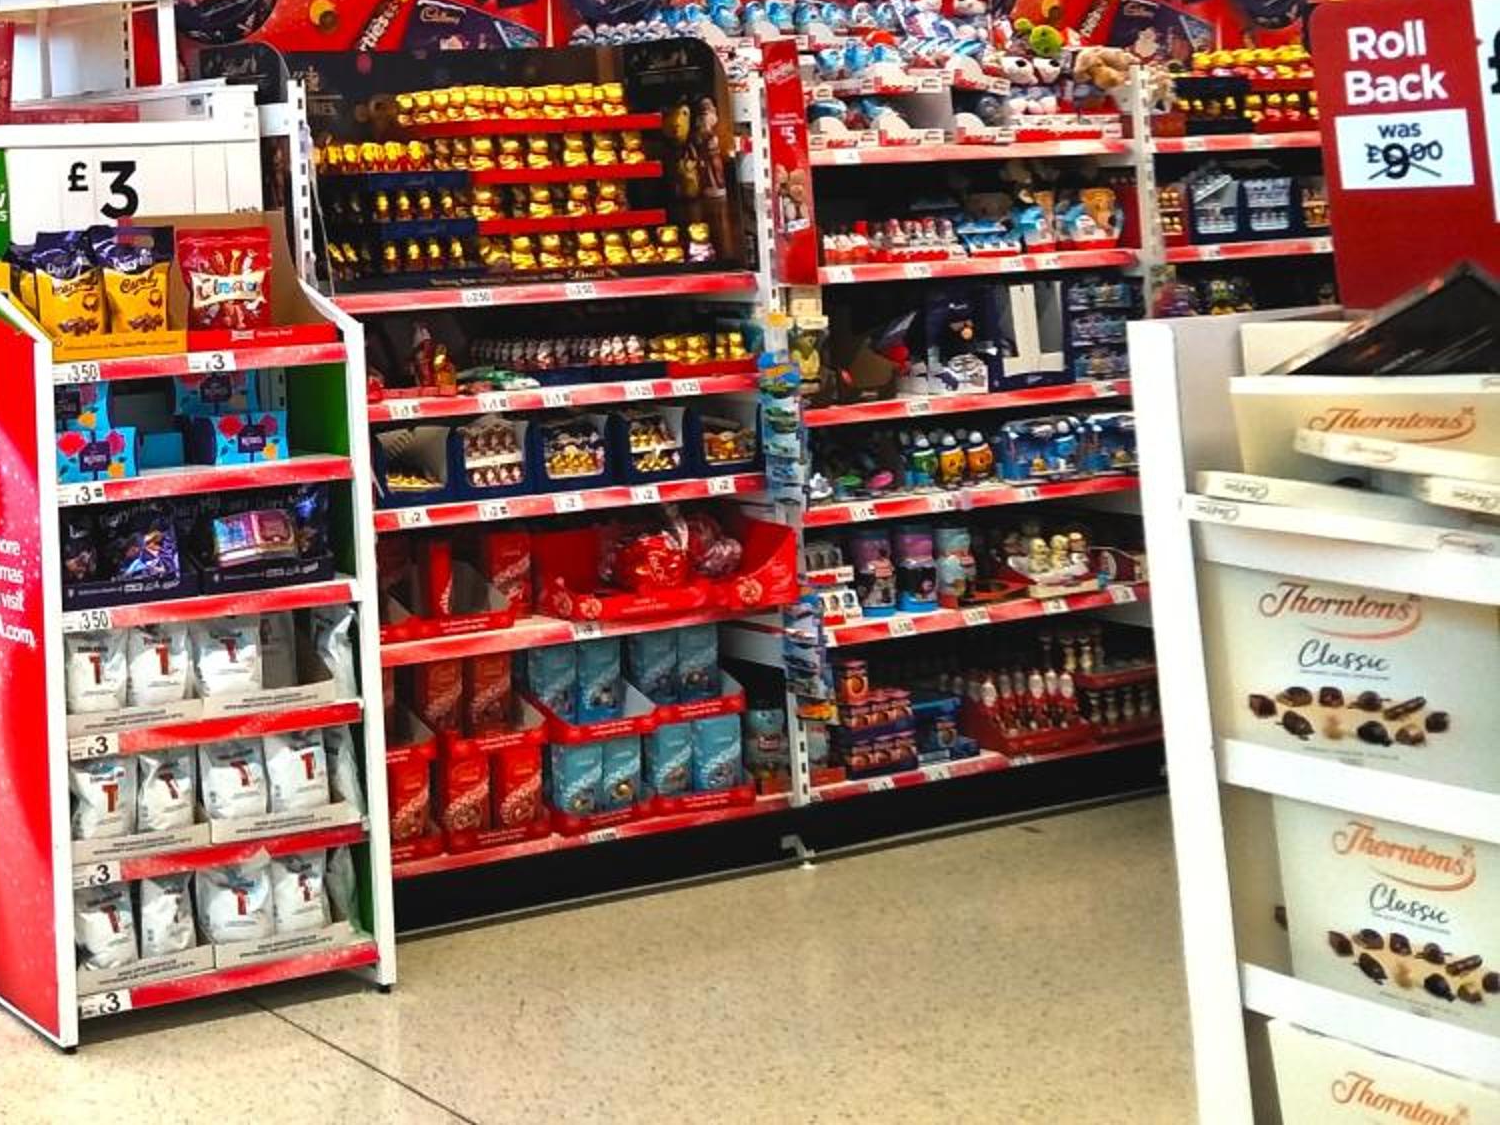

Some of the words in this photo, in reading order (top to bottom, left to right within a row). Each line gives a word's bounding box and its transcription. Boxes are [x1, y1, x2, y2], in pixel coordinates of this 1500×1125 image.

[1347, 19, 1428, 62] Roll
[1344, 62, 1449, 106] Back
[1378, 123, 1423, 139] was
[1308, 407, 1468, 433] Thorntons
[1259, 581, 1422, 641] Thorntons
[1298, 638, 1392, 673] Classic
[1332, 821, 1477, 892] Thorntons
[1369, 882, 1450, 925] Classic
